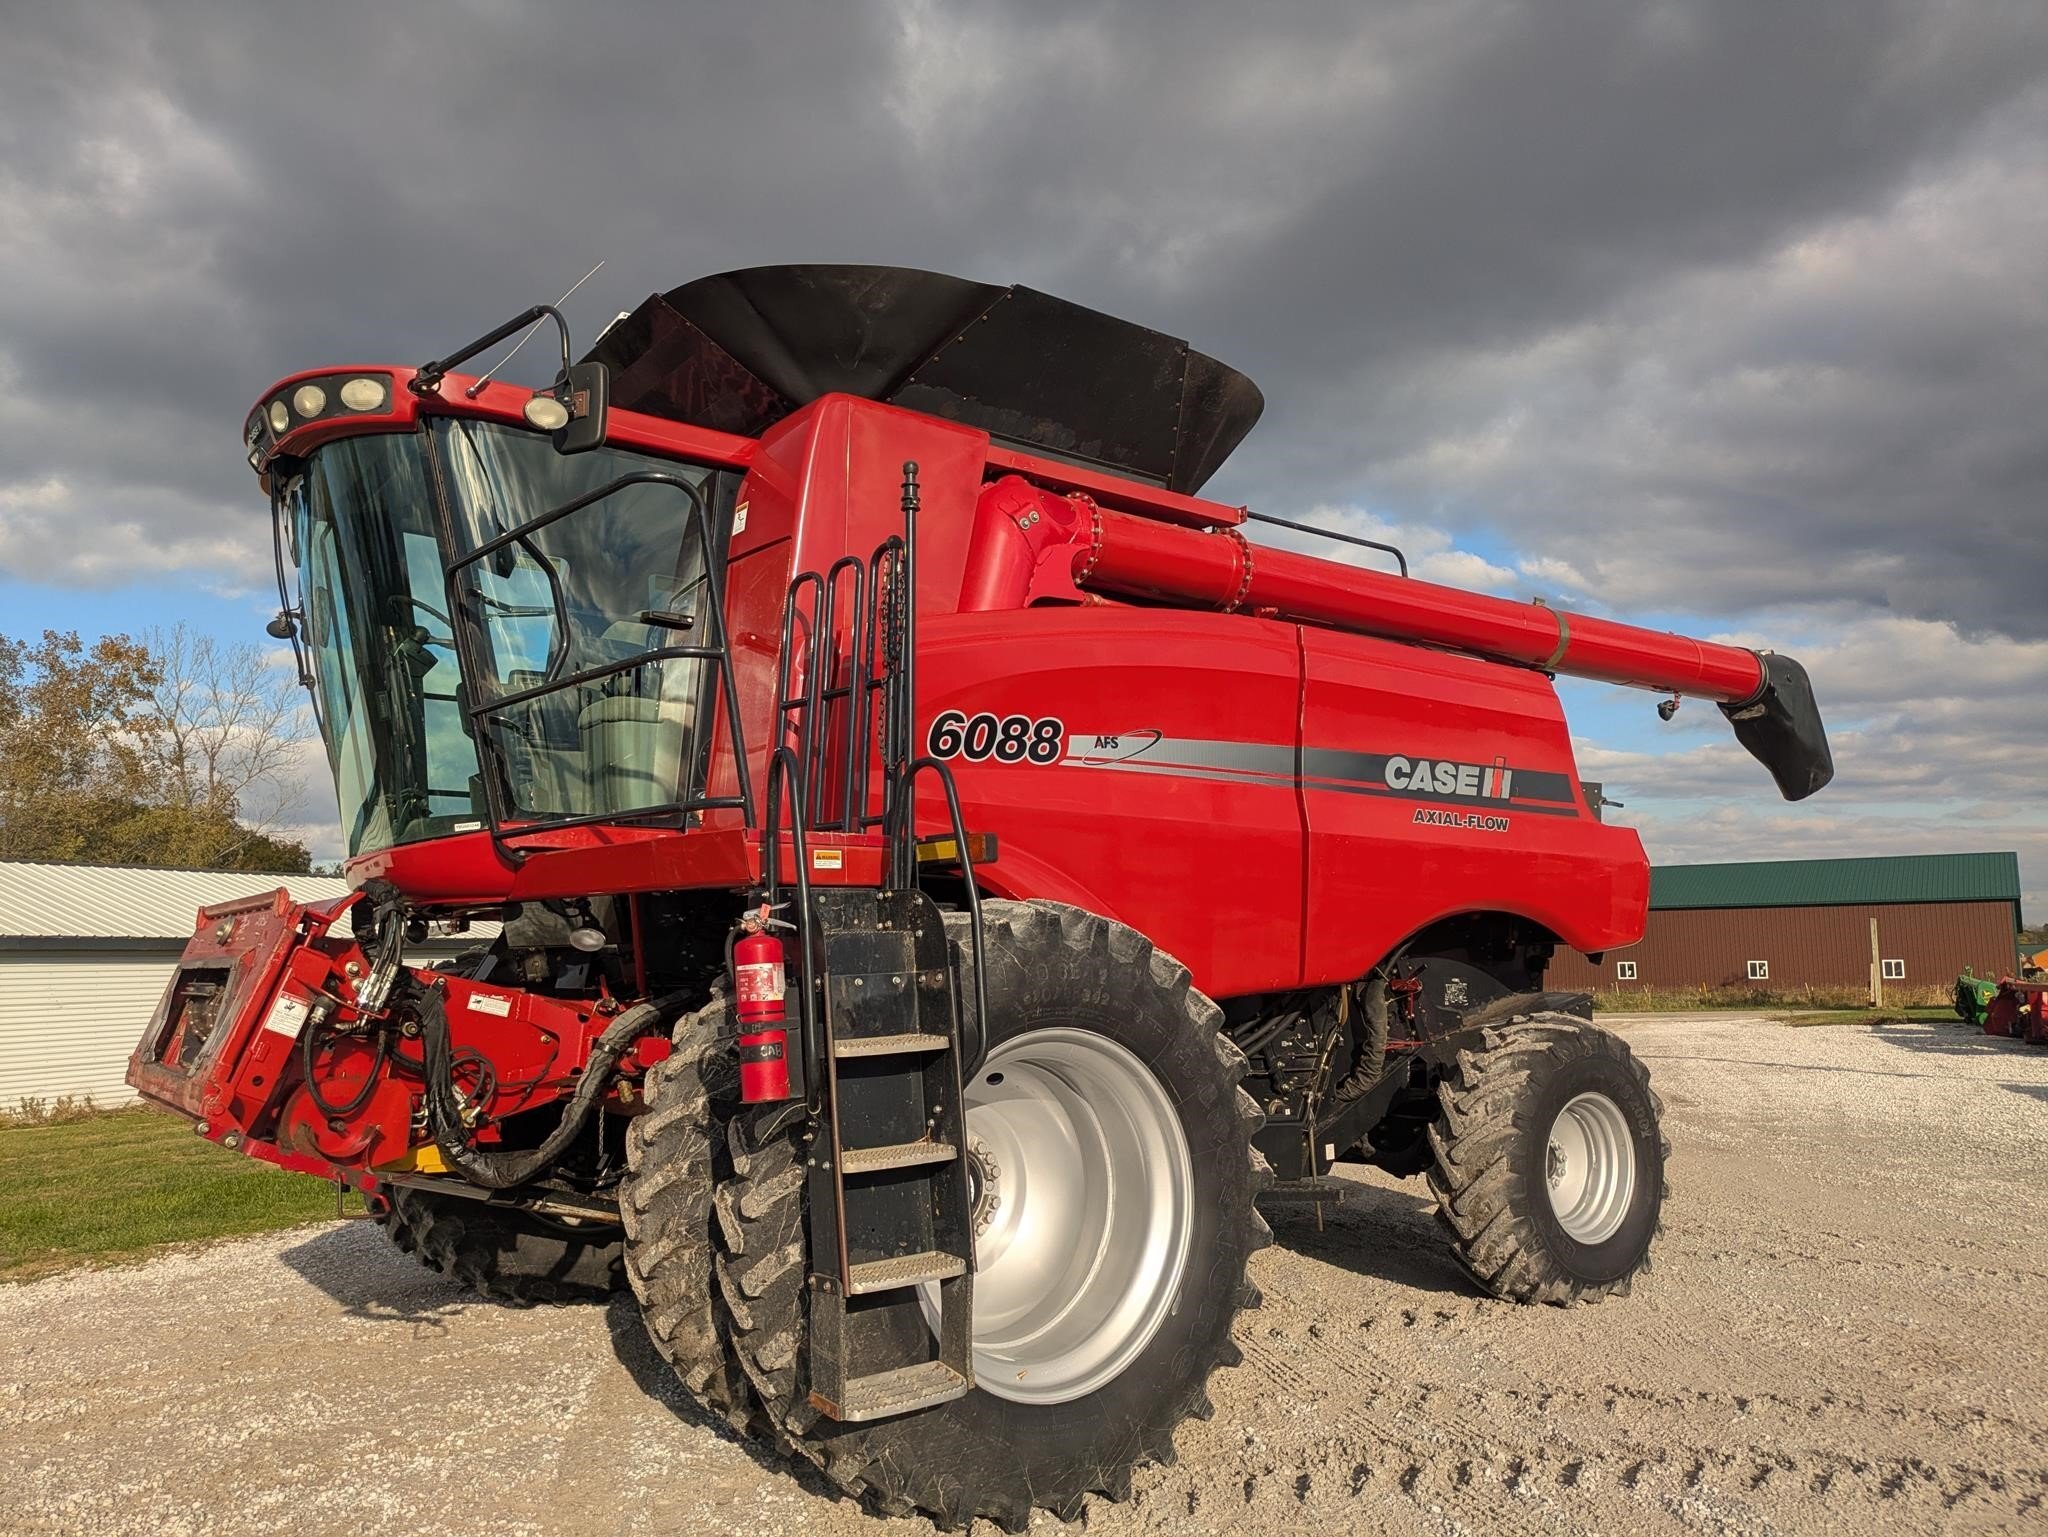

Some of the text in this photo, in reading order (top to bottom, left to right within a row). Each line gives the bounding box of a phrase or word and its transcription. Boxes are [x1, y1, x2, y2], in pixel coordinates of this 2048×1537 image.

[927, 709, 1064, 765] 6088
[1094, 736, 1119, 749] AFS
[1384, 756, 1480, 796] CASE
[1413, 809, 1509, 832] AXIAL-FLOW
